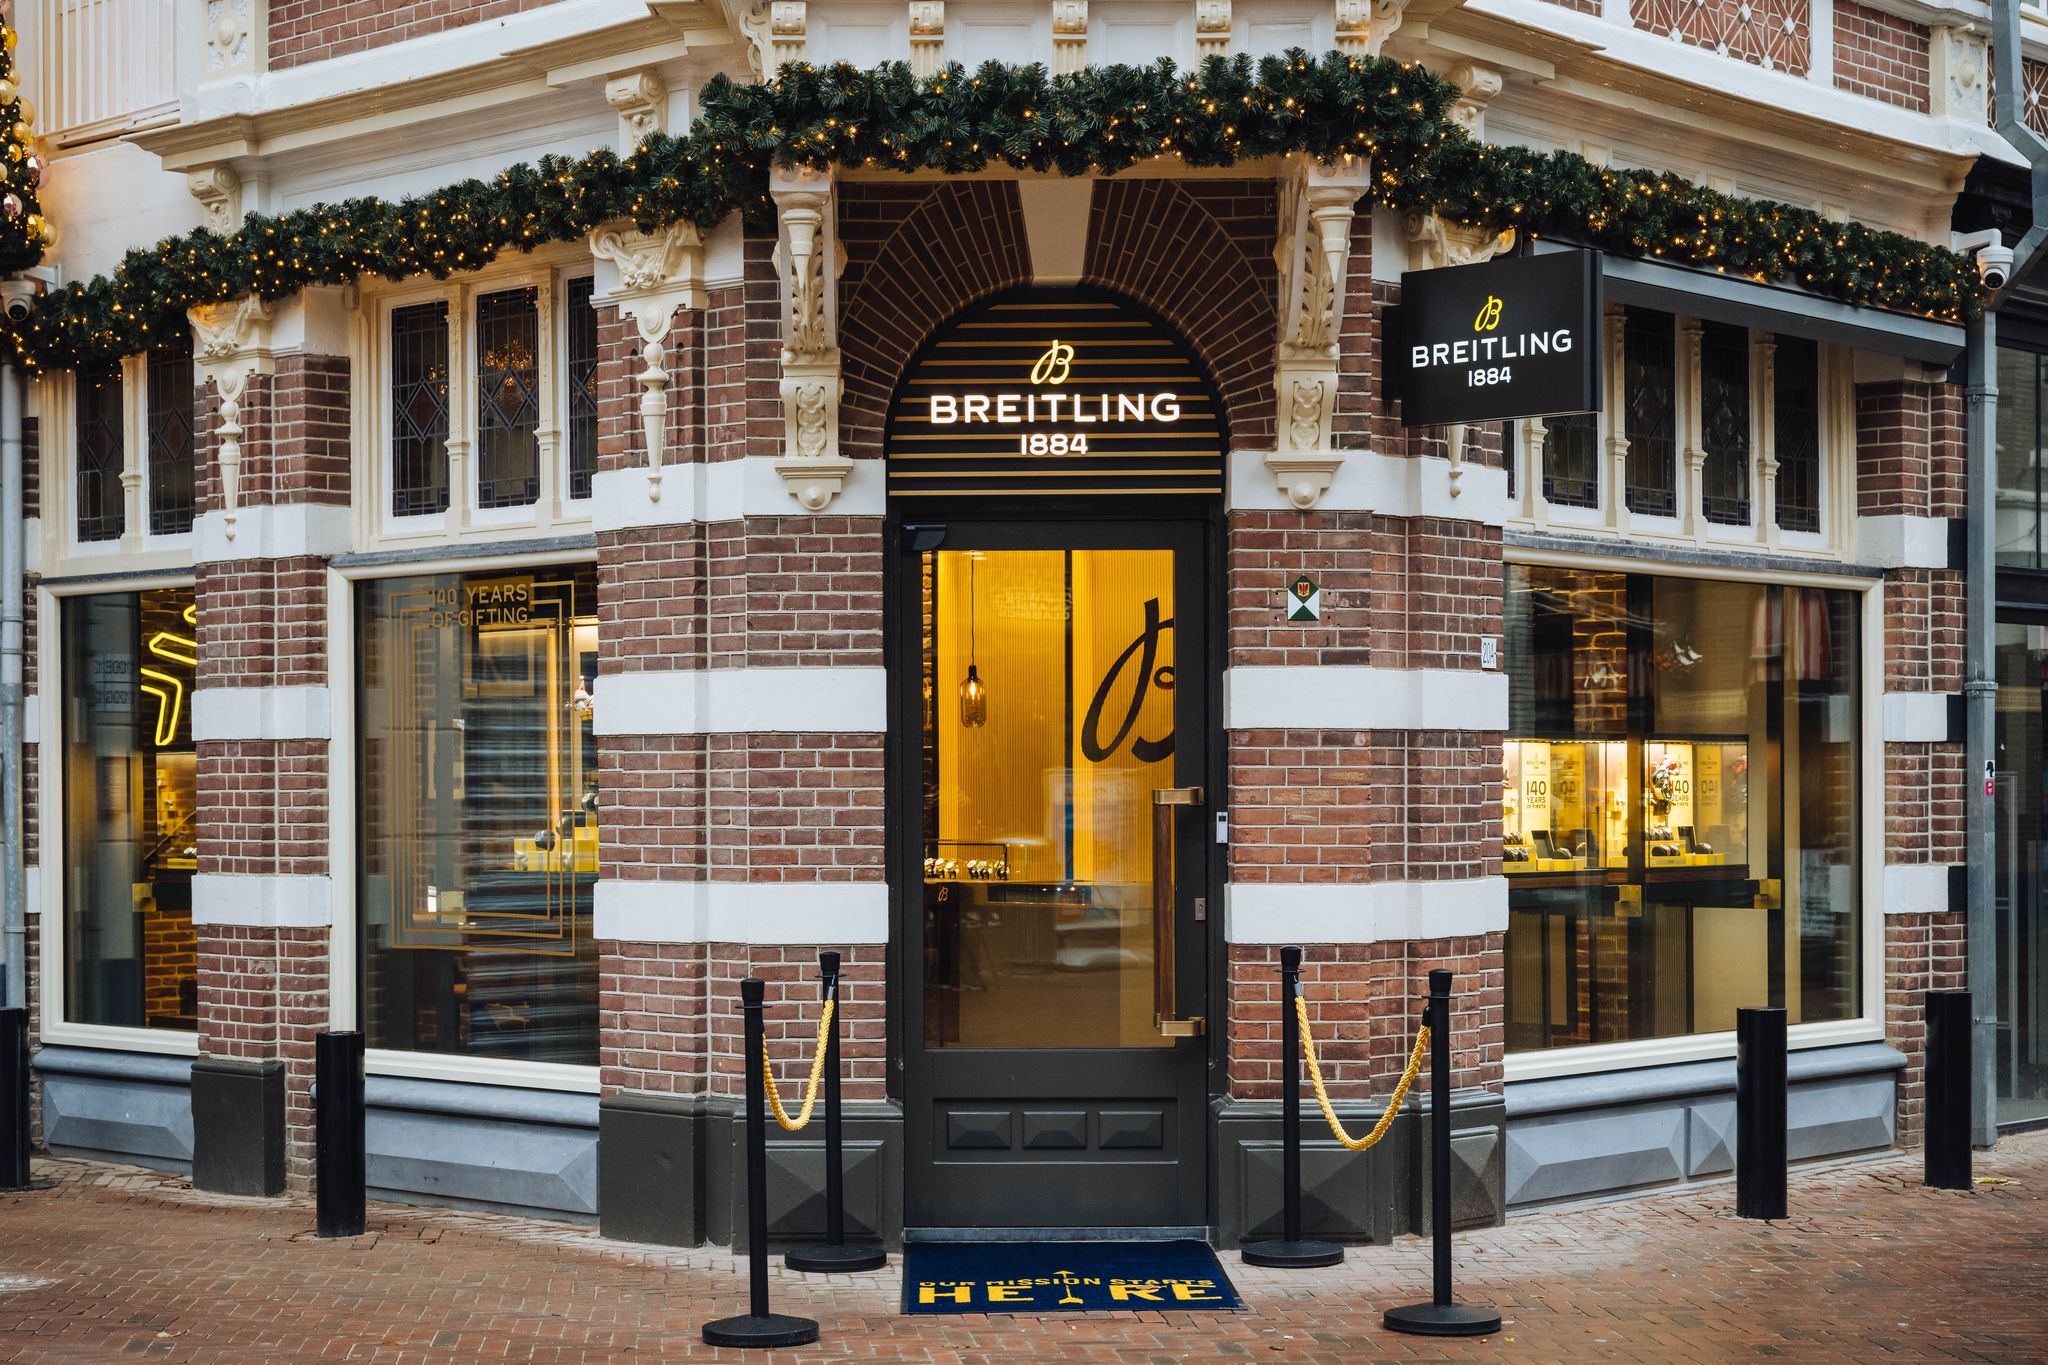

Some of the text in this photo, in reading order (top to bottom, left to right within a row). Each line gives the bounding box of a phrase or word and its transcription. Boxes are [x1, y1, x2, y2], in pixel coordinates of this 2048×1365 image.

[1412, 329, 1572, 368] BREITLING
[1468, 366, 1512, 387] 1884
[930, 393, 1180, 423] BREITLING
[1020, 434, 1088, 456] 1884
[431, 584, 527, 606] 140 YEARS
[432, 606, 528, 628] OF GIFTING
[1526, 780, 1547, 796] 140
[986, 1278, 1101, 1286] MISSION
